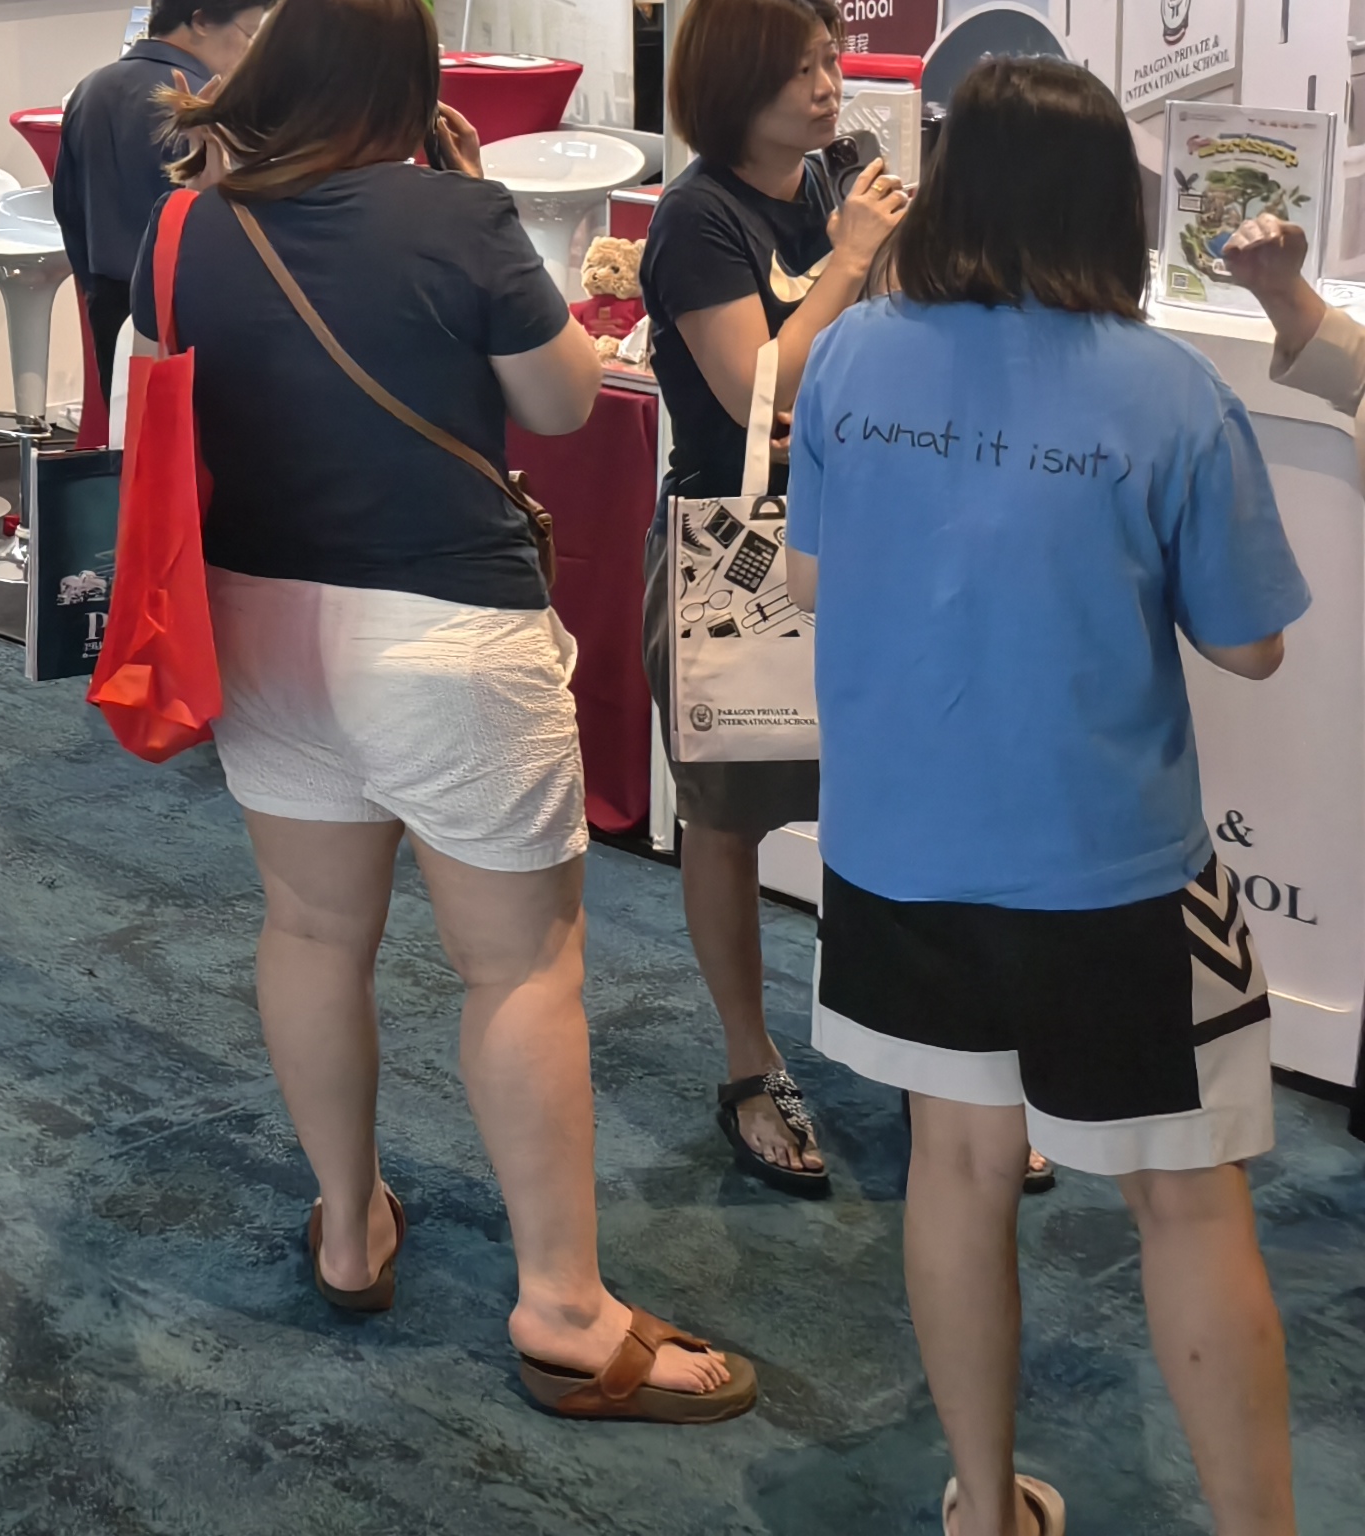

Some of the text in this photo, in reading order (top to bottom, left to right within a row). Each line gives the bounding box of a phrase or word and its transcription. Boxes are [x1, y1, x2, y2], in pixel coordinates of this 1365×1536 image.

[1125, 49, 1229, 103] INTERNATIONAL SCHOOL
[1134, 54, 1173, 82] PARAGON
[1174, 37, 1211, 63] PRIVATE
[976, 430, 1008, 467] it
[718, 708, 755, 716] PARAGON
[757, 708, 790, 716] PRIVATE
[718, 718, 817, 726] INTERNATIONAL SCHOOL
[1216, 810, 1254, 848] &
